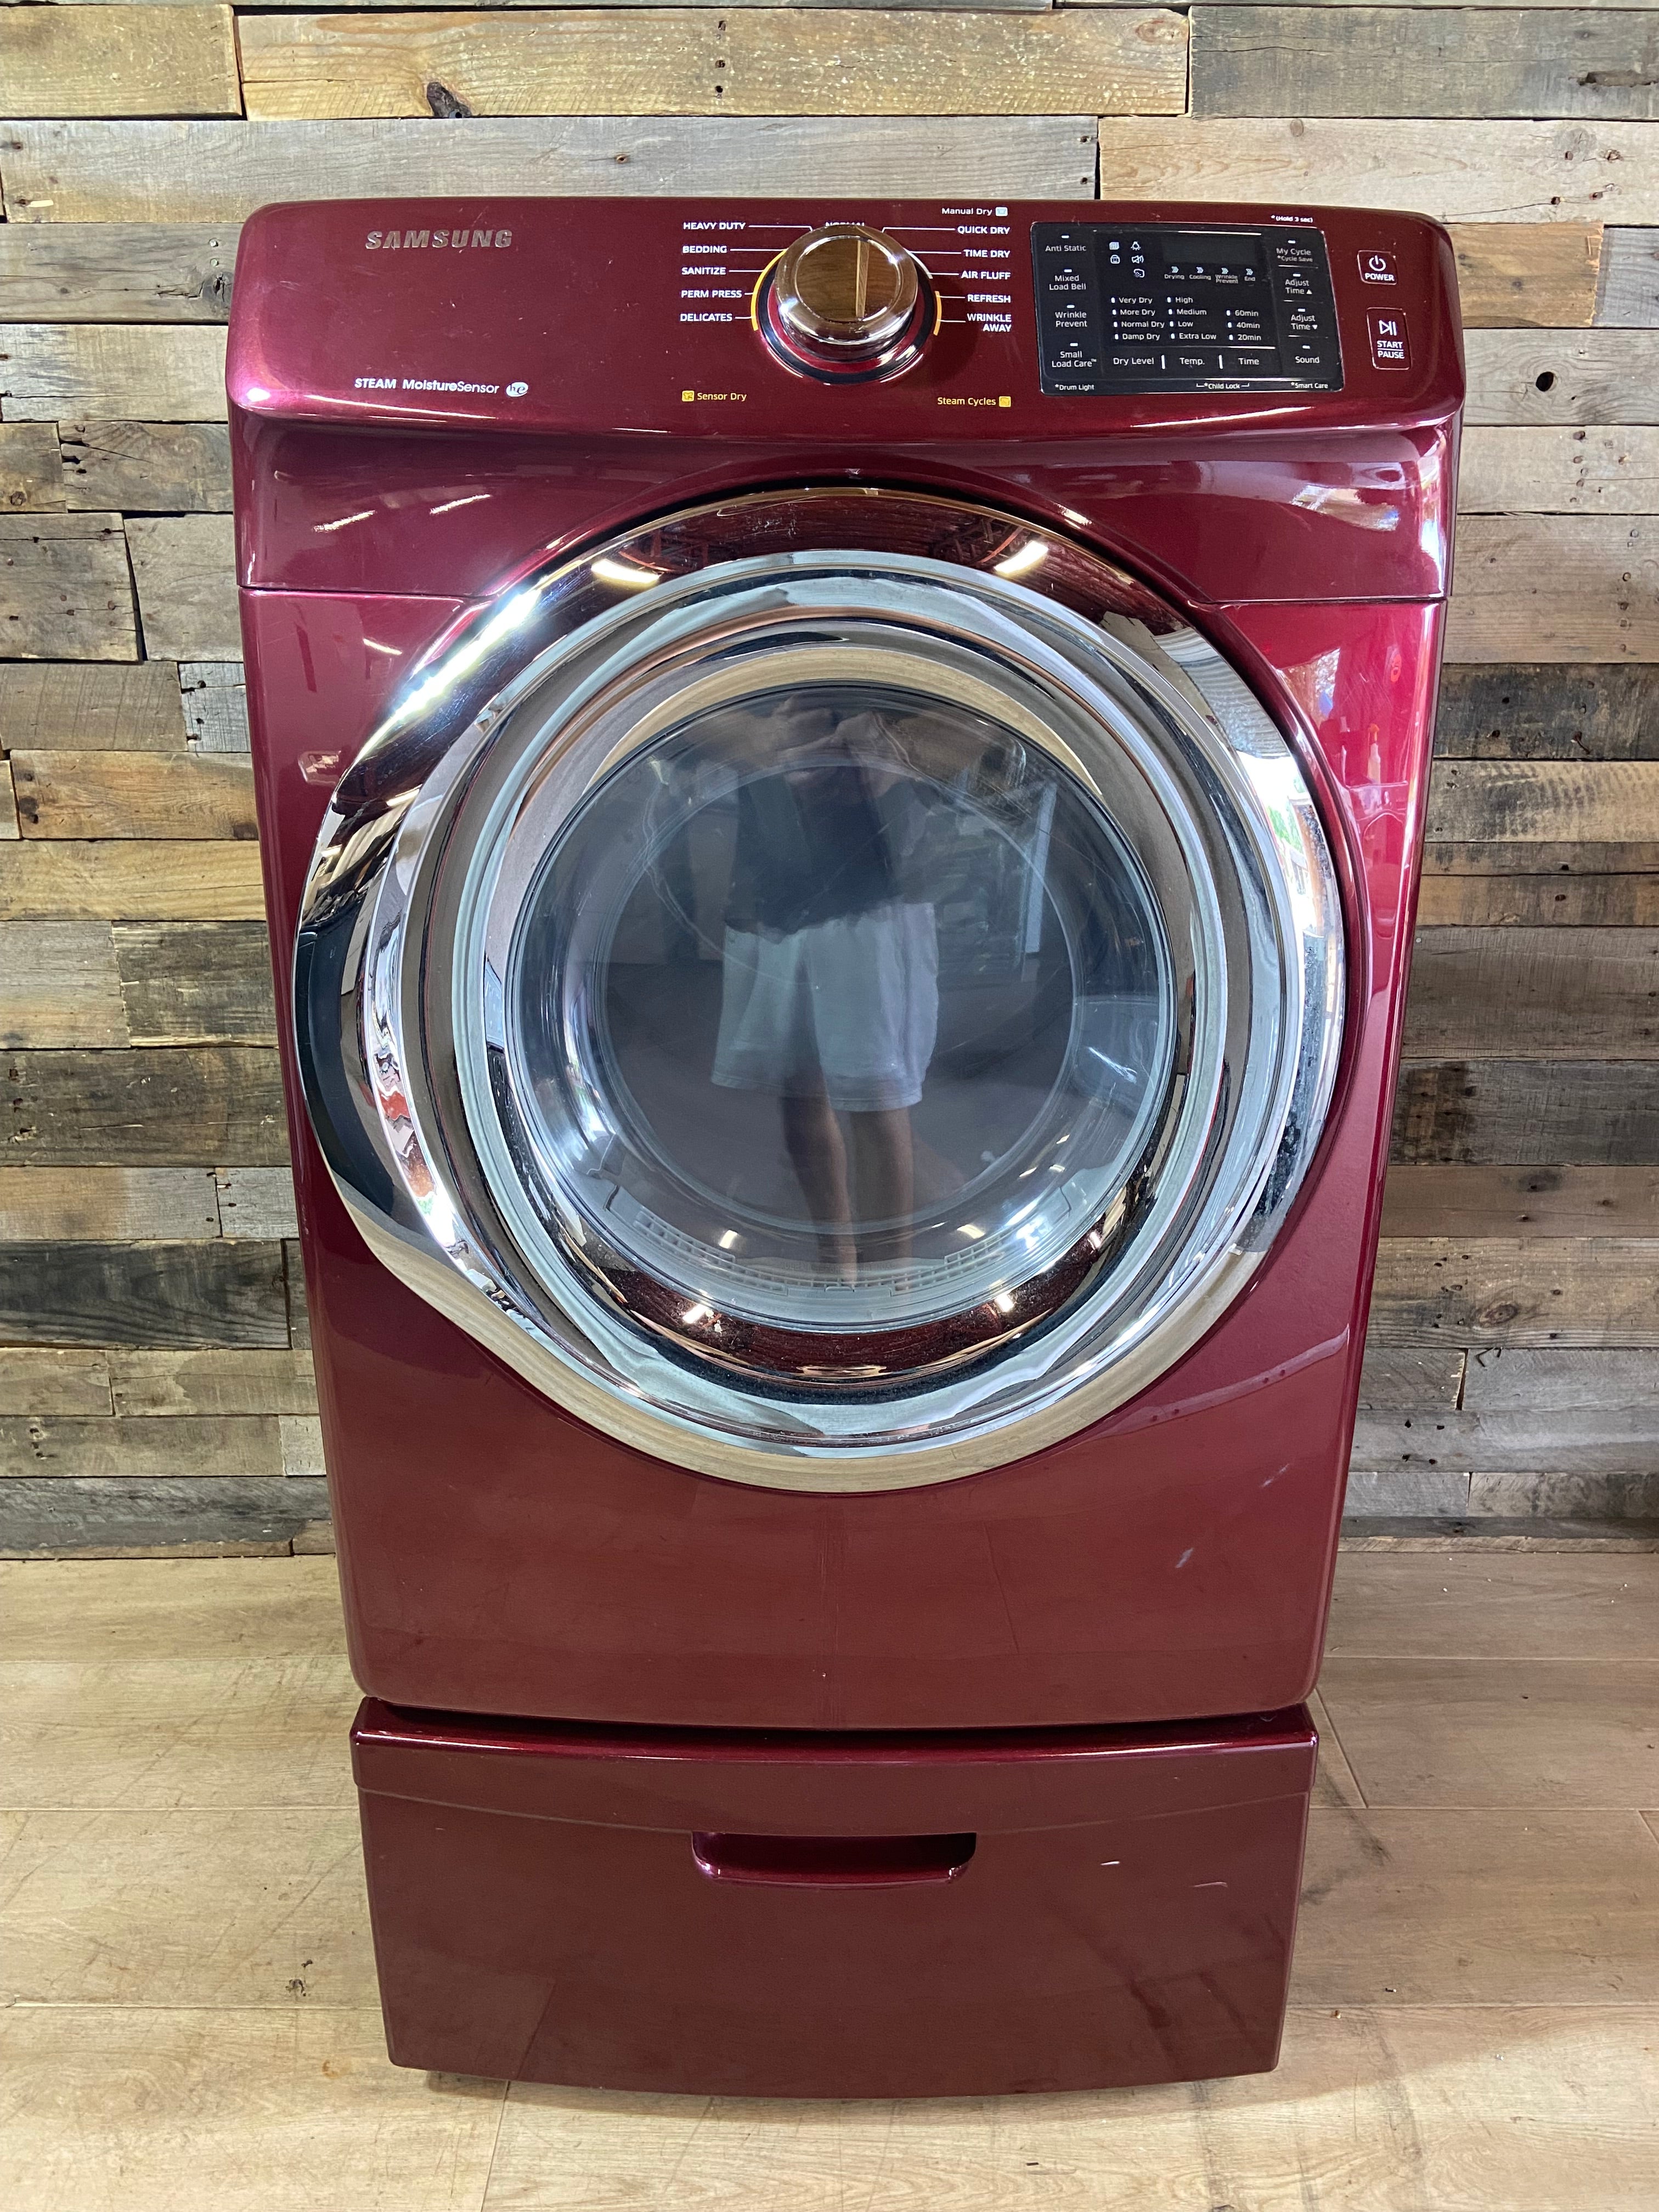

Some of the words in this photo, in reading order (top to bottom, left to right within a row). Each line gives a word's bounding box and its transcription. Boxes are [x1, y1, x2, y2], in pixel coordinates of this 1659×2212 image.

[957, 226, 988, 235] QUICK
[989, 226, 1010, 234] DRY
[365, 230, 512, 249] SAMSUNG
[964, 250, 988, 258] TIME
[1290, 249, 1311, 257] Cycle
[961, 271, 978, 279] AIR
[1285, 279, 1309, 287] Adjust
[1119, 296, 1136, 304] Very
[1176, 296, 1193, 304] High
[967, 314, 1012, 322] WRINKLE
[1291, 314, 1315, 323] Adjust
[1122, 332, 1144, 341] Damp
[1146, 333, 1160, 341] Dry
[1378, 351, 1404, 359] PAUSE
[1052, 359, 1072, 368] Load
[1113, 357, 1129, 366] Dry
[1132, 357, 1154, 365] Level
[1180, 357, 1205, 366] Temp.
[1295, 356, 1319, 364] Sound
[354, 377, 397, 389] STEAM
[402, 379, 500, 394] MoistureSensor
[697, 392, 727, 400] Sensor
[731, 393, 747, 403] Dry
[938, 397, 965, 405] Steam
[968, 397, 996, 407] Cycles
